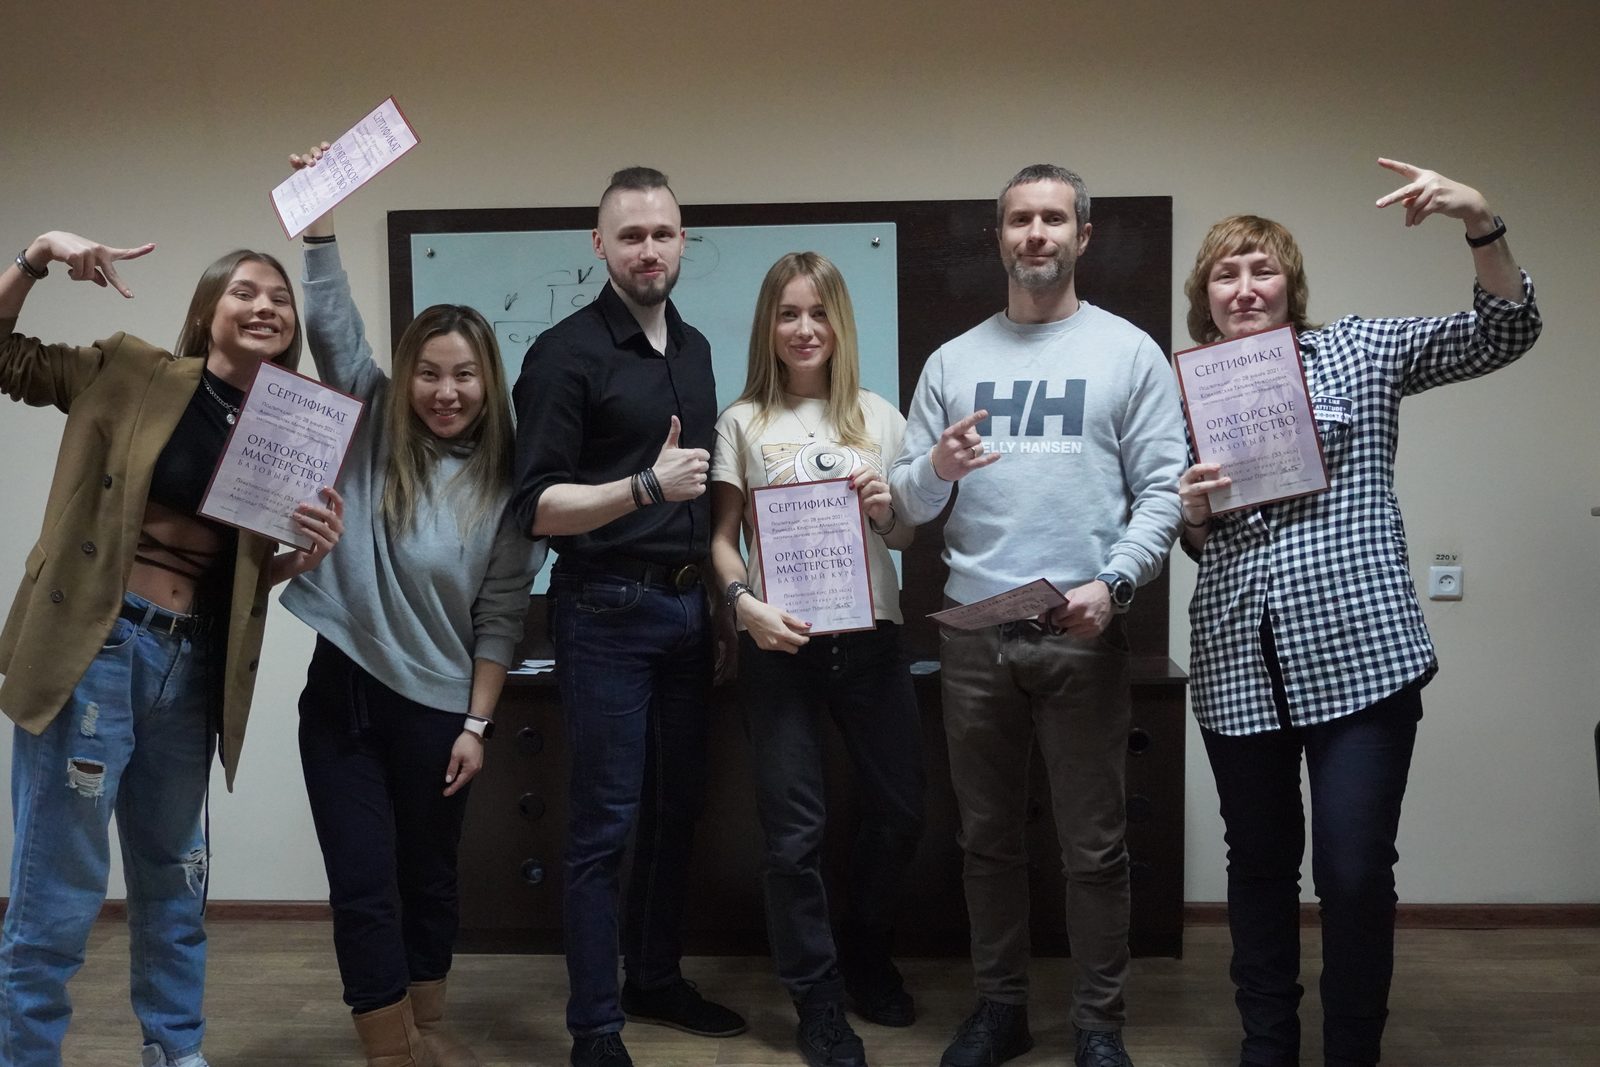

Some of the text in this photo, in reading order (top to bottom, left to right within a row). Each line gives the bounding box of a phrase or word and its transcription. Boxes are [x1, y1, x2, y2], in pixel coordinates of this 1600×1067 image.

[333, 143, 359, 184] ОРАТОРСКОЕ
[1206, 401, 1295, 430] ОРАТОРСКОЕ
[248, 434, 328, 471] ОРАТОРСКОЕ
[982, 441, 1082, 454] ELLY HANSEN
[1212, 428, 1301, 454] БАЗОВЫЙ КУРС
[237, 459, 290, 483] БАЗОВЫЙ
[775, 545, 853, 562] ОРАТОРСКОЕ
[778, 570, 855, 584] БАЗОВЫЙ КУРС
